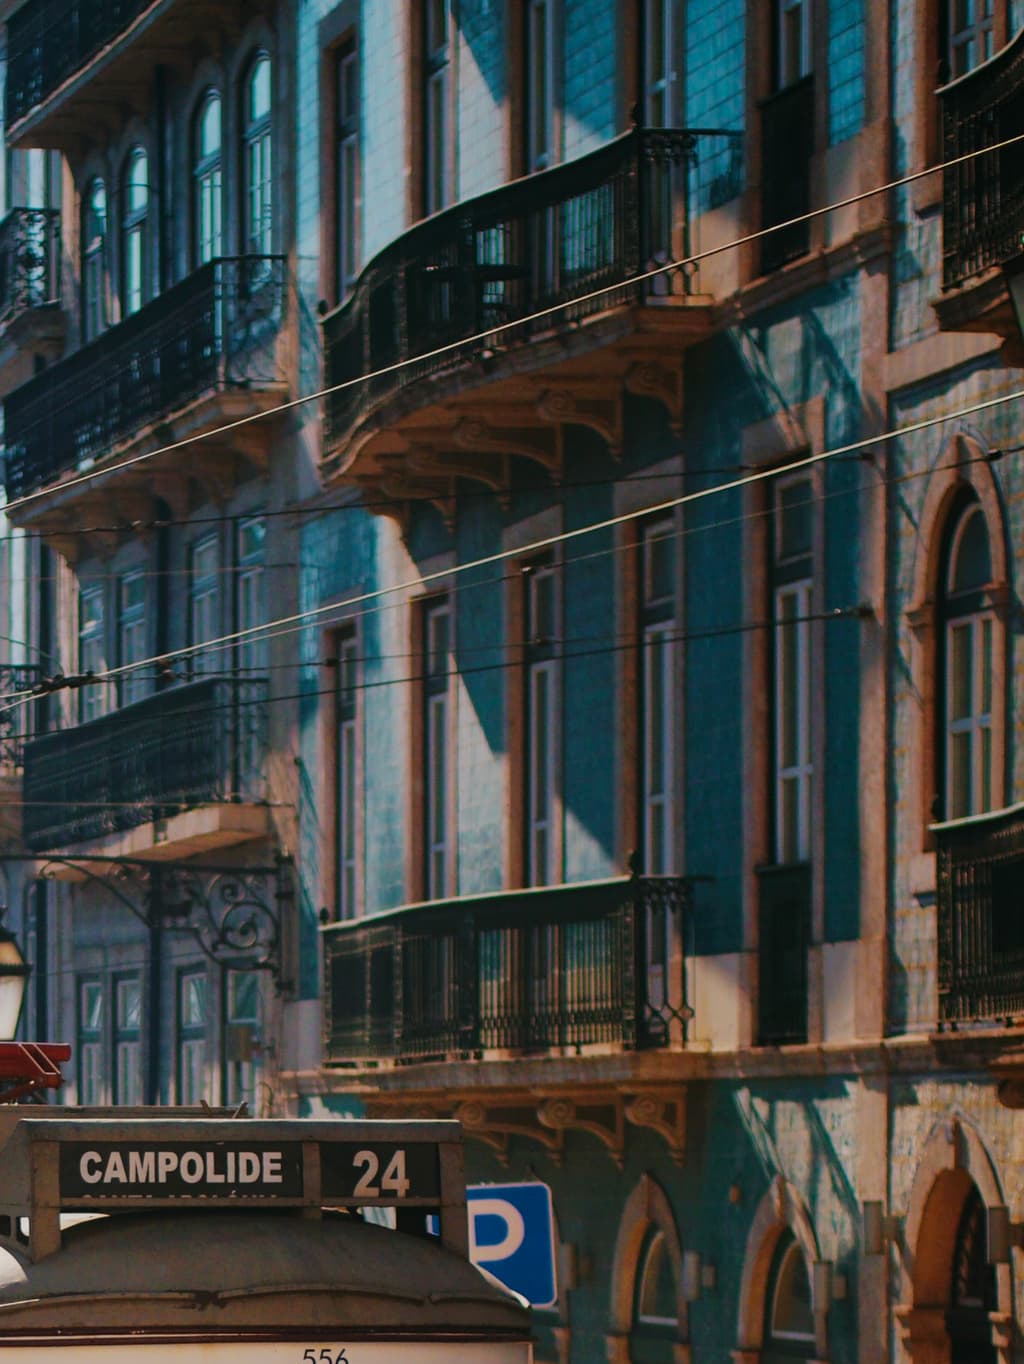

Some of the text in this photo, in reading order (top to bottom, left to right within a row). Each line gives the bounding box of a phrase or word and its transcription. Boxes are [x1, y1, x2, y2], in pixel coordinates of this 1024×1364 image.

[79, 1150, 284, 1184] CAMPOLIDE
[352, 1150, 410, 1197] 24
[467, 1198, 525, 1262] P
